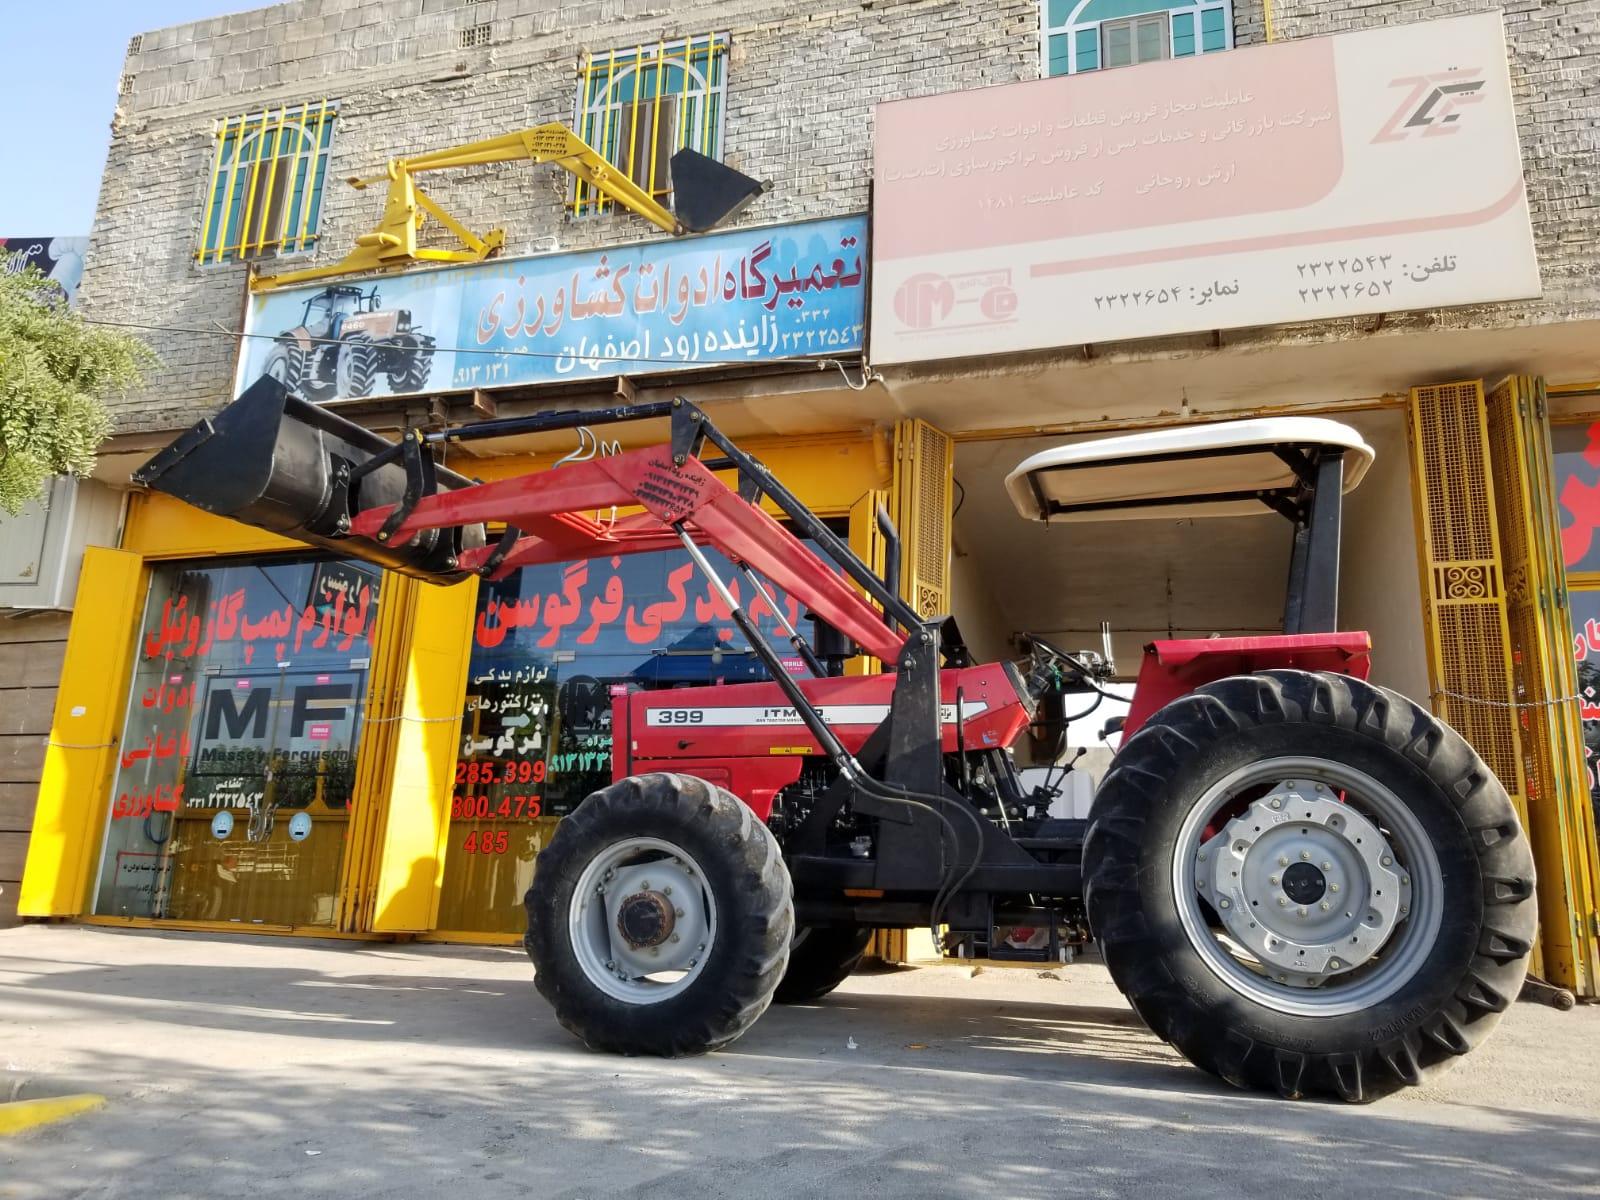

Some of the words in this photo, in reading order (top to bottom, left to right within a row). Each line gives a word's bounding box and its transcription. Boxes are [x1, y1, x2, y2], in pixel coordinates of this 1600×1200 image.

[722, 236, 863, 311] تعمیرگاه
[1402, 255, 1457, 282] تلفن:
[476, 255, 632, 345] کشاورزی
[634, 255, 722, 325] ادوات
[1190, 280, 1239, 305] نمابر:
[555, 329, 650, 374] اصفهان
[476, 554, 624, 648] فرگوسن
[241, 603, 293, 666] پمپ
[294, 585, 370, 653] لوازم
[474, 667, 512, 688] یدکی
[516, 665, 549, 684] لوازم
[142, 682, 197, 714] ادوات
[659, 711, 703, 723] 399
[463, 723, 543, 756] فرگوسن
[112, 784, 184, 819] کشاورزی
[464, 831, 509, 854] 485
